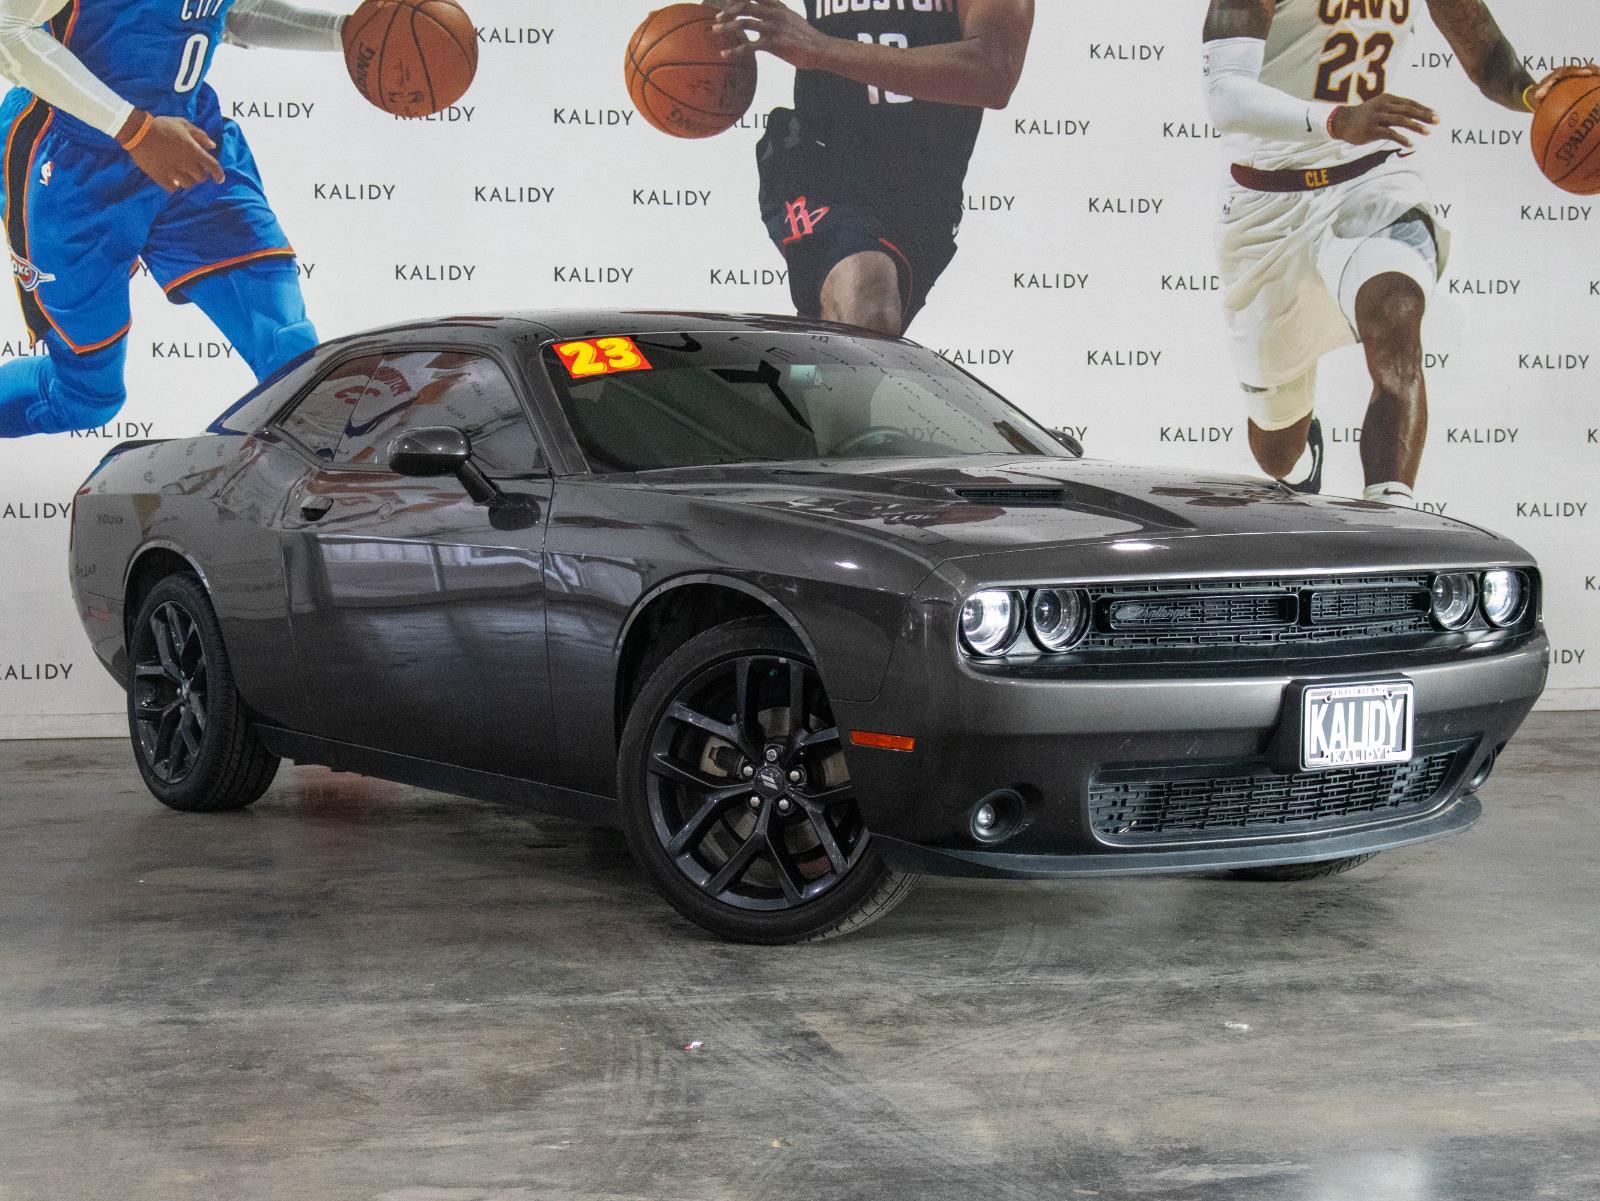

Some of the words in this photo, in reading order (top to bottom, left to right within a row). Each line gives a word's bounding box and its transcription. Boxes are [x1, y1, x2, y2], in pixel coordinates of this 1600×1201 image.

[475, 27, 554, 44] KALIDY
[1089, 43, 1165, 61] KALIDY
[174, 33, 209, 93] 0
[1313, 29, 1395, 104] 23
[1412, 53, 1453, 68] IDY
[232, 101, 314, 119] KALIDY
[554, 108, 634, 126] KALIDY
[1015, 119, 1090, 136] KALIDY
[1452, 129, 1523, 145] KALIDY
[1305, 169, 1329, 188] CLE
[314, 184, 395, 200] KALIDY
[475, 186, 555, 203] KALIDY
[633, 189, 711, 206] KALIDY
[960, 196, 1015, 211] LIDY
[1088, 198, 1163, 214] KALIDY
[1521, 206, 1592, 221] KALIDY
[395, 265, 475, 281] KALIDY
[554, 266, 634, 283] KALIDY
[711, 269, 788, 285] KALIDY
[1014, 273, 1089, 289] KALIDY
[1161, 275, 1220, 291] KALID
[1450, 280, 1521, 295] KALIDY
[152, 342, 233, 359] KALIDY
[560, 338, 642, 375] 23
[1088, 351, 1161, 366] KALIDY
[1518, 354, 1589, 370] KALIDY
[1160, 427, 1233, 443] KALIDY
[1447, 428, 1518, 444] KALIDY
[2, 502, 71, 519] ALIDY
[1516, 503, 1587, 517] KALIDY
[1549, 649, 1585, 664] IDY
[0, 663, 73, 680] ALIDY
[1310, 698, 1404, 756] KALIDY
